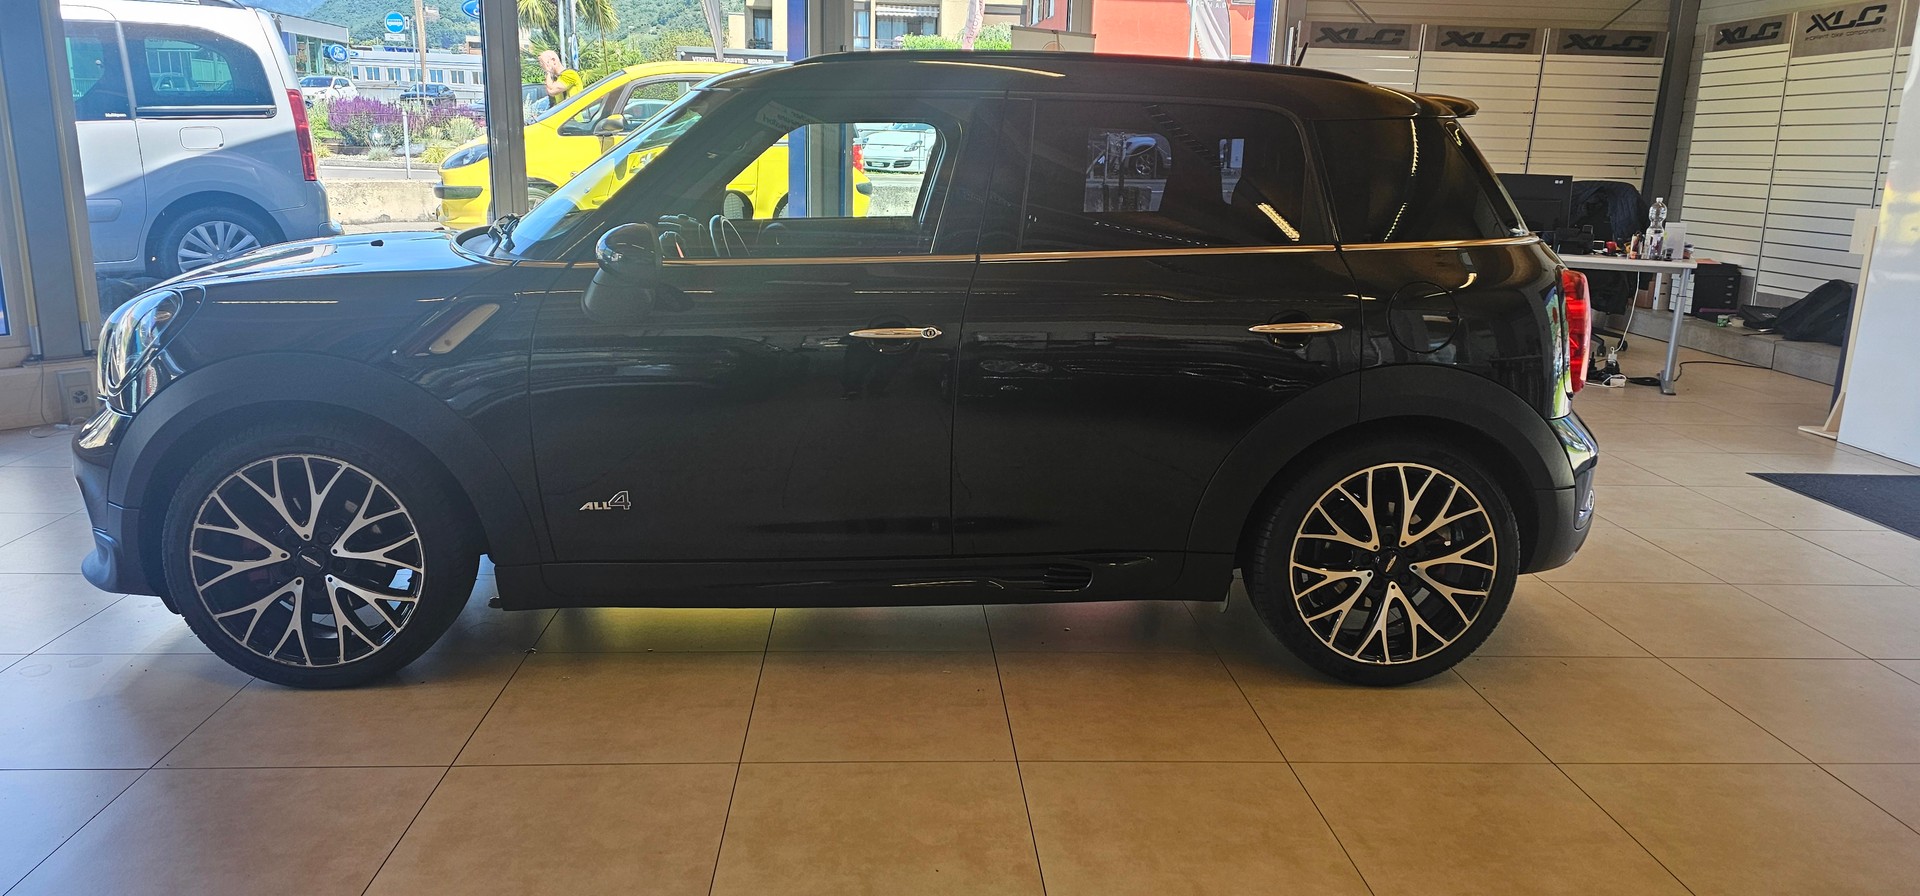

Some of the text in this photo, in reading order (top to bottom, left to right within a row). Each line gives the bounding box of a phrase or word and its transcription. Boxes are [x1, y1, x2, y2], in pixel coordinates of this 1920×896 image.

[1806, 4, 1888, 33] XLC
[1315, 27, 1405, 44] XLC
[1441, 31, 1531, 49] XLC
[1563, 34, 1652, 51] XLC
[1716, 22, 1782, 46] XLC
